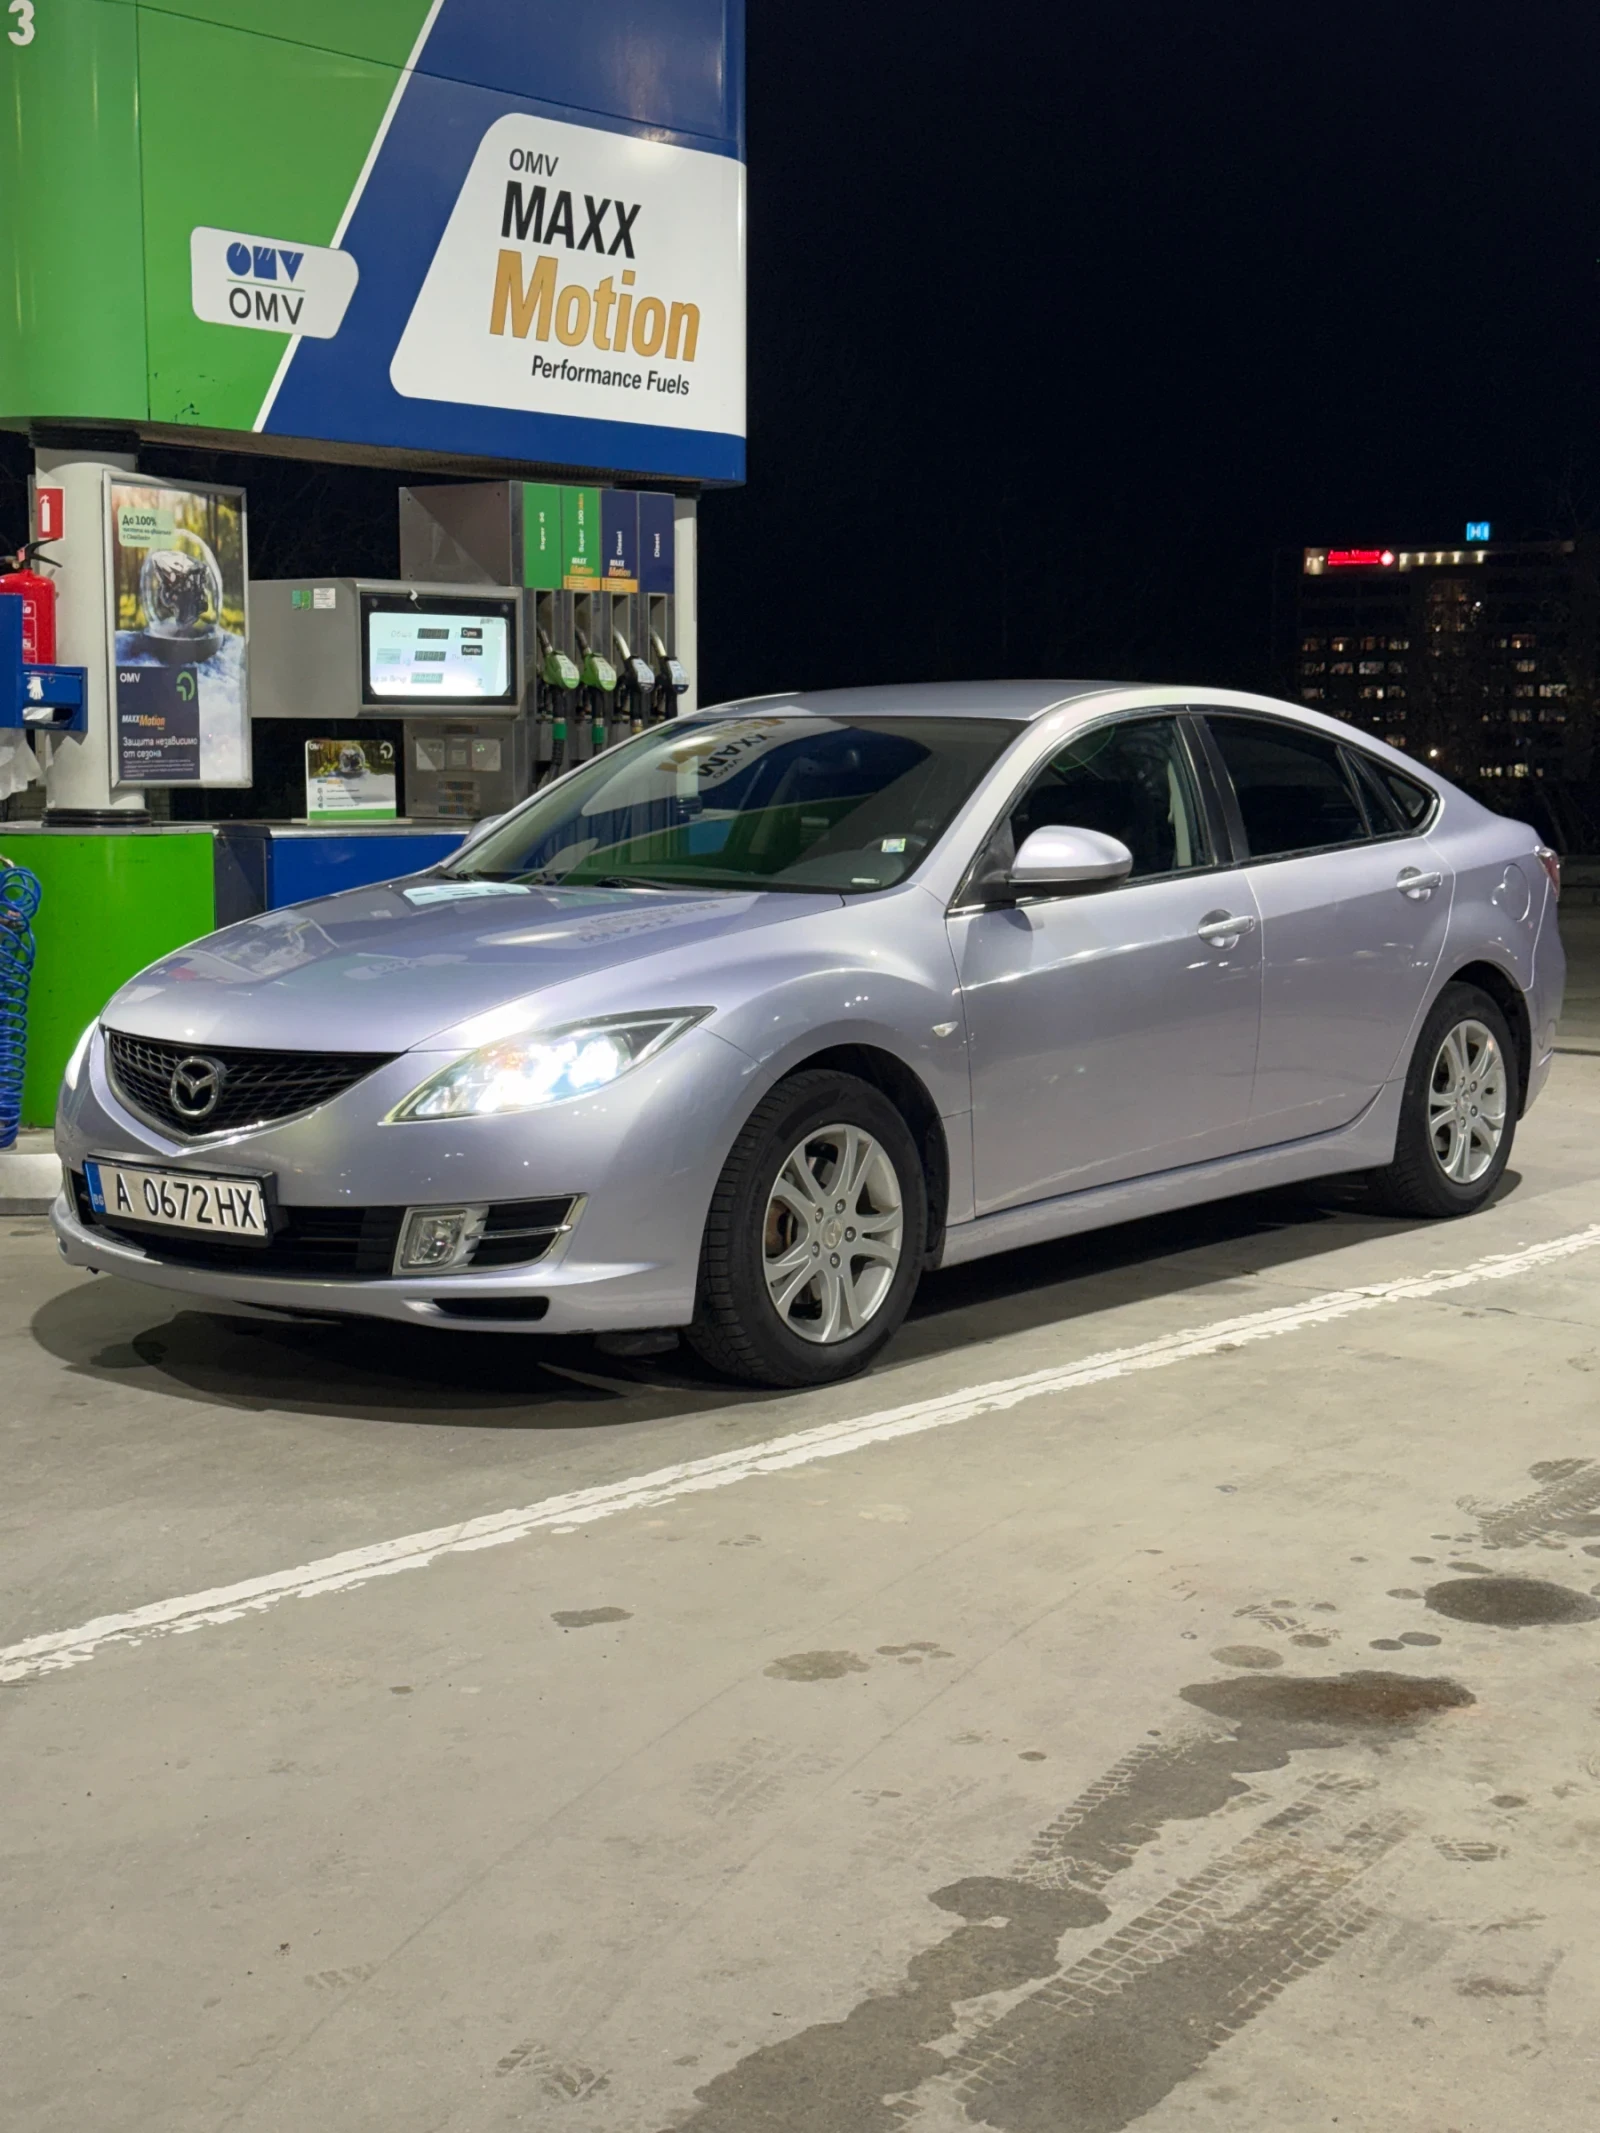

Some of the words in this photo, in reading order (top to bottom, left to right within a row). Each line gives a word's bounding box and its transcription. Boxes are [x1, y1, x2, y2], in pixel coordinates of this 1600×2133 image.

[8, 0, 35, 46] 3
[508, 148, 559, 177] OMV
[501, 180, 642, 259] MAXX
[229, 287, 304, 325] OMV
[489, 248, 700, 362] Motion
[531, 355, 642, 389] Performance
[646, 370, 690, 396] Fuels
[120, 672, 141, 683] OMV
[123, 736, 154, 747] Защита
[155, 735, 198, 748] независимо
[123, 750, 136, 759] от
[137, 750, 162, 760] сезона
[116, 1173, 134, 1212] A
